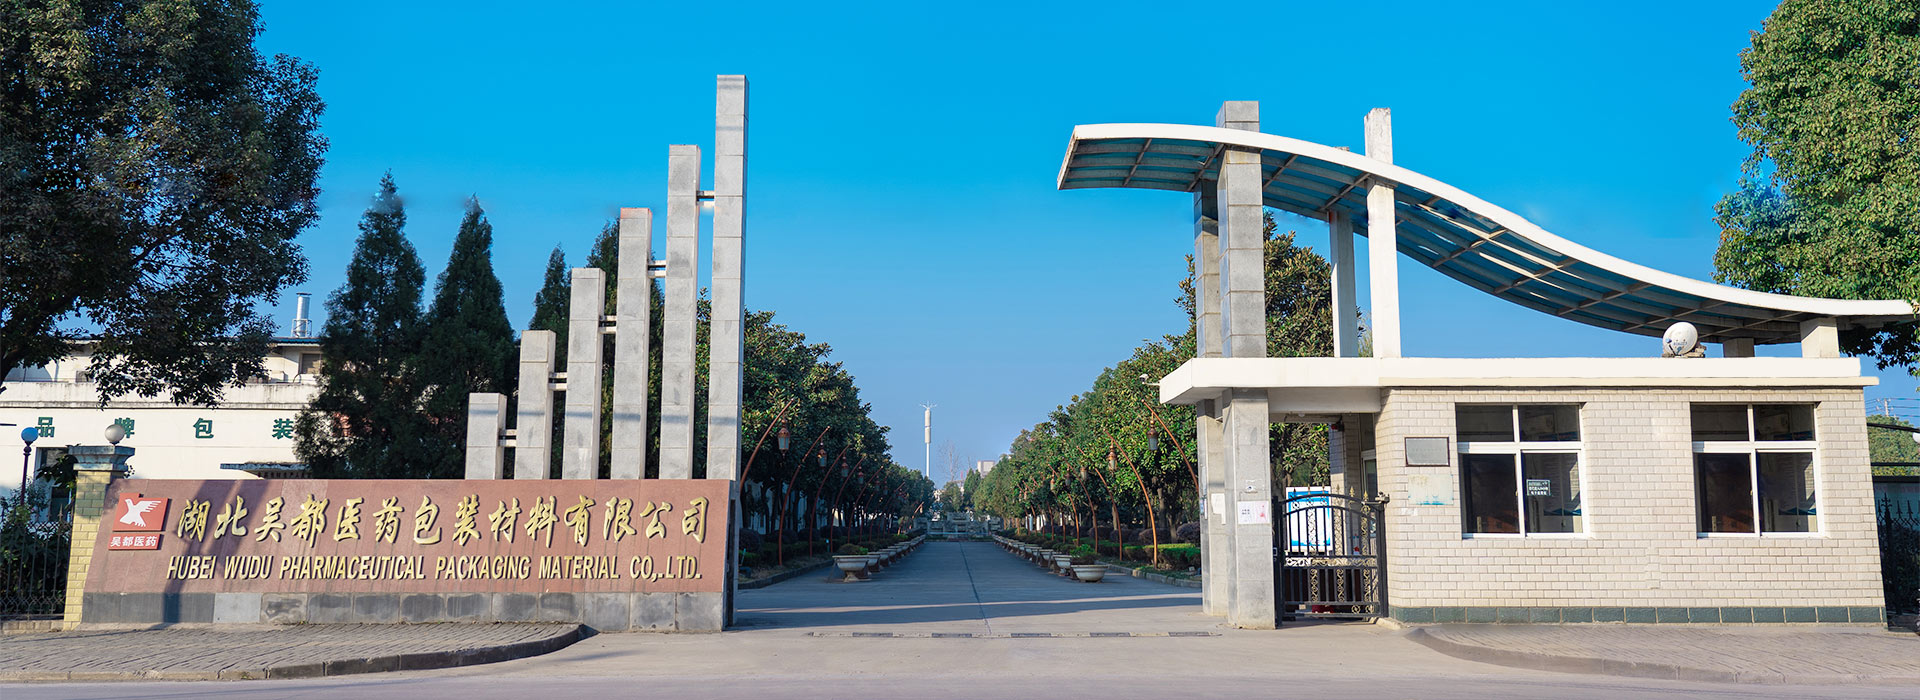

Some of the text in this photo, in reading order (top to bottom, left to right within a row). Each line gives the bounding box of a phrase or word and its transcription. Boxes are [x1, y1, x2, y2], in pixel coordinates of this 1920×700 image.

[177, 493, 709, 548] 湖北吴都医药包装材料有限公司
[110, 536, 157, 547] 吴都医药
[166, 555, 215, 580] HUBEI
[223, 555, 273, 580] WUDU
[279, 555, 426, 580] PHARMACEUTICAL
[435, 556, 531, 580] PACKAGING
[538, 556, 621, 580] MATERIAL
